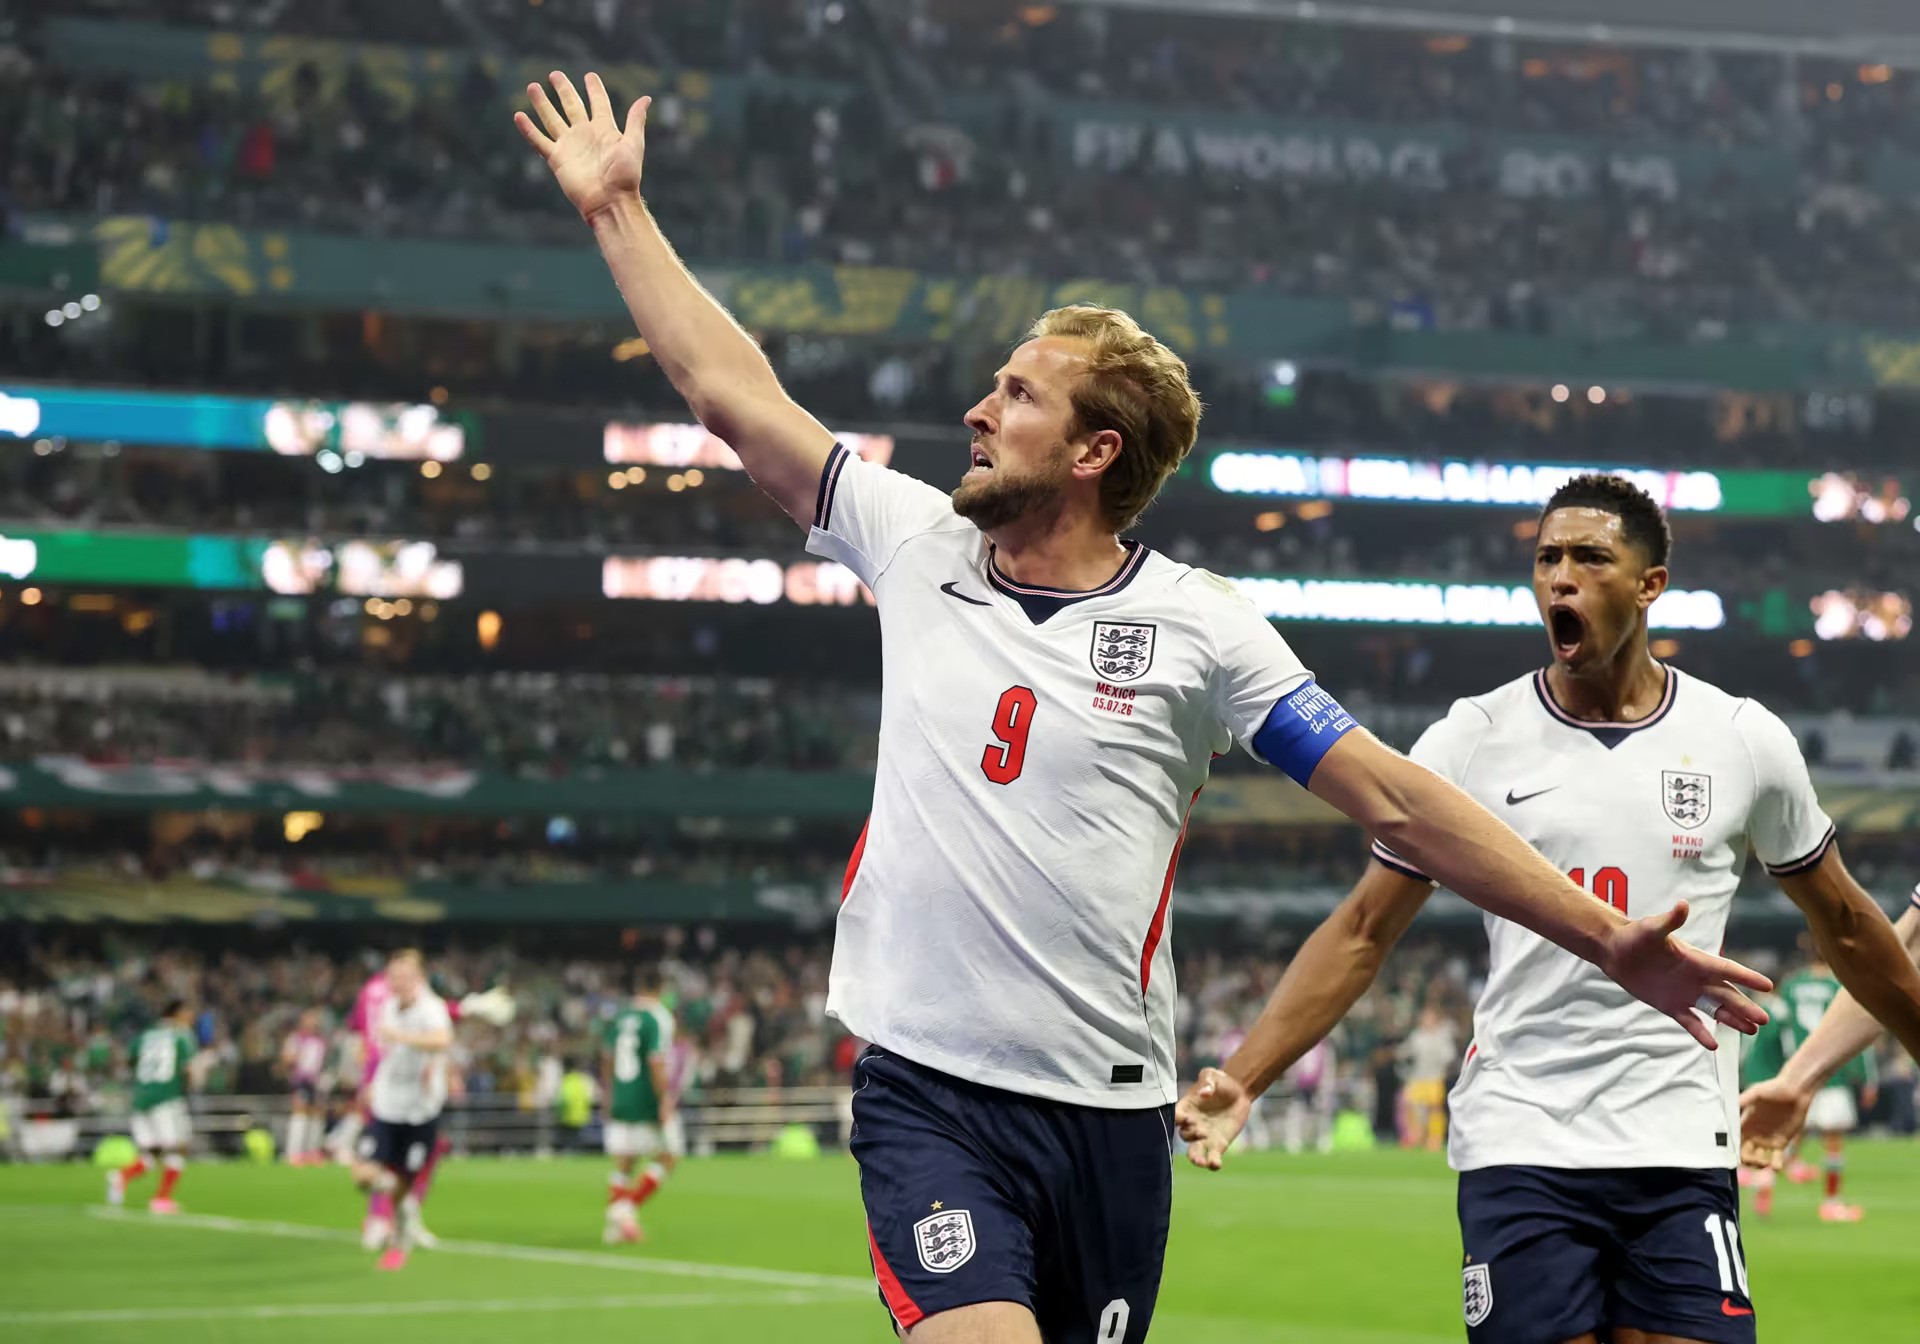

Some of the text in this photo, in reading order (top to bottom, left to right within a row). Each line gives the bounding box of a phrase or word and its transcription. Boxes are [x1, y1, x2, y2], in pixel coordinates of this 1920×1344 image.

[1095, 681, 1136, 700] MEXICO
[1092, 696, 1133, 716] 05.07.26
[981, 685, 1038, 785] 9
[1309, 718, 1329, 735] the
[1672, 834, 1703, 848] MEXICO
[1567, 866, 1630, 917] 0
